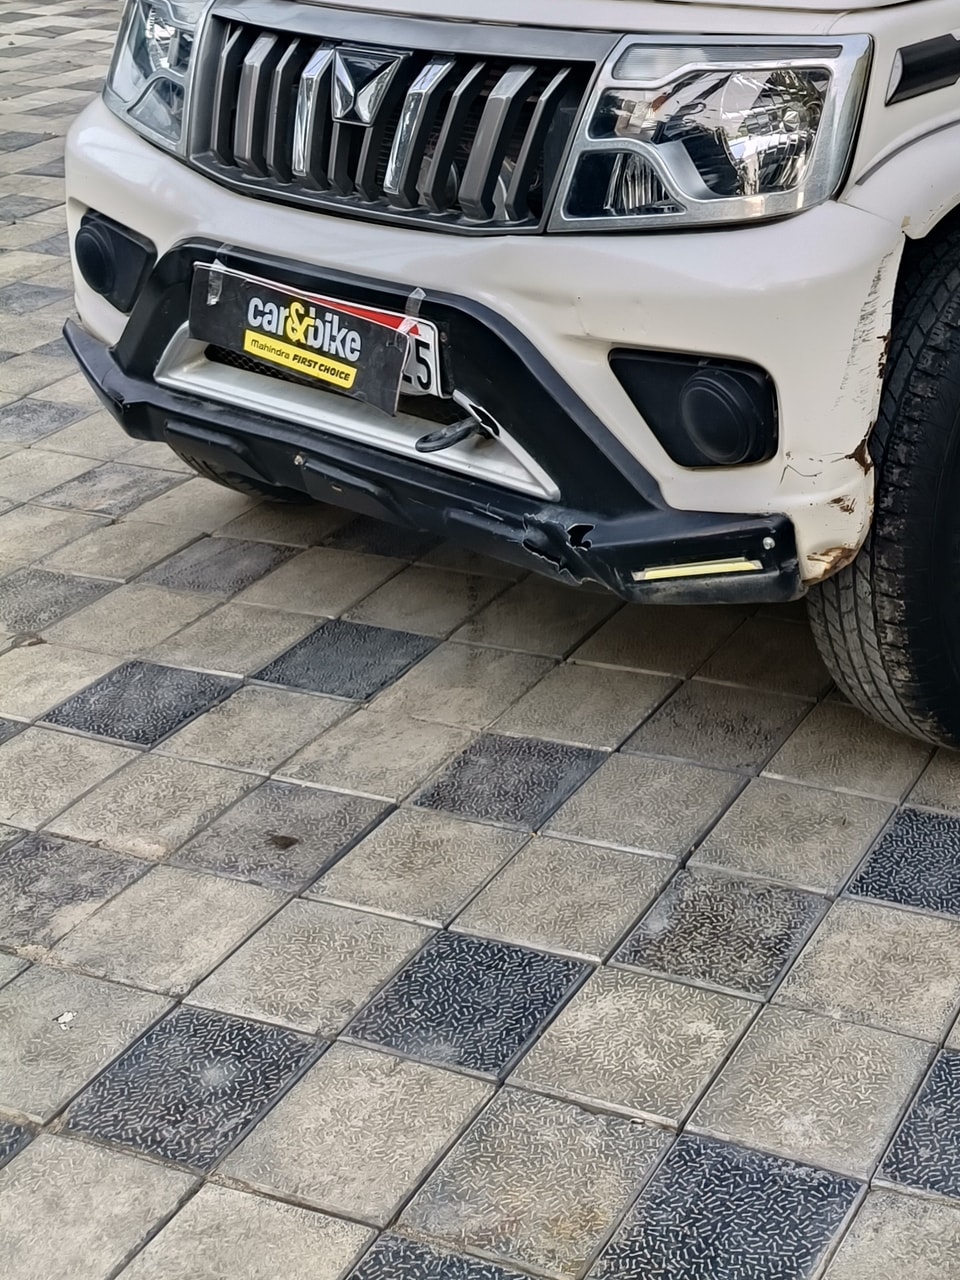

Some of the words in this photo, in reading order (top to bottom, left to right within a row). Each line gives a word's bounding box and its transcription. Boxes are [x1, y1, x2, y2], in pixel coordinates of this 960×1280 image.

[247, 297, 362, 362] car&bike
[250, 338, 290, 360] Mahindra
[292, 354, 319, 370] FIRST
[318, 364, 351, 382] CHOICE
